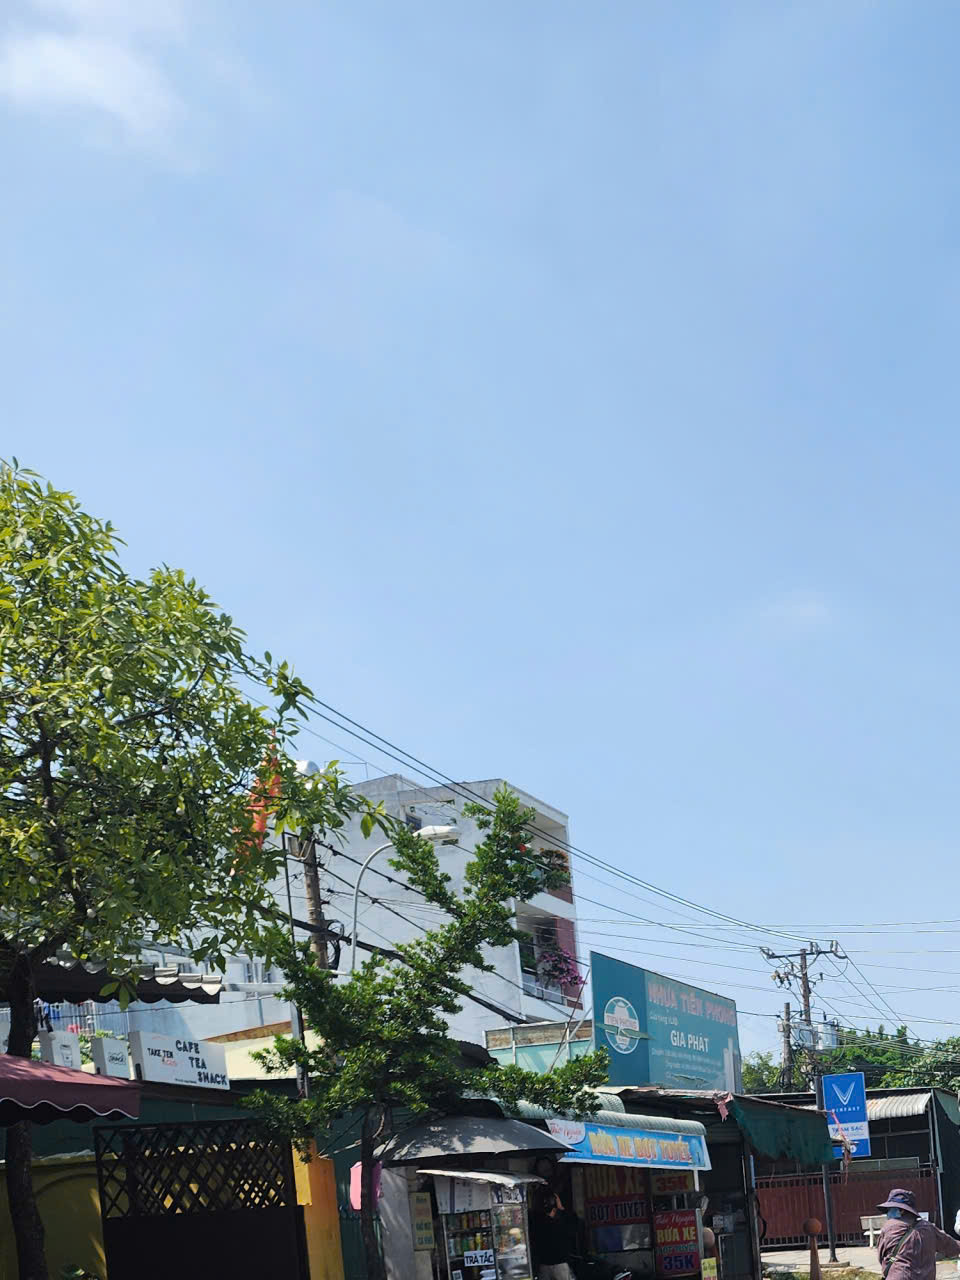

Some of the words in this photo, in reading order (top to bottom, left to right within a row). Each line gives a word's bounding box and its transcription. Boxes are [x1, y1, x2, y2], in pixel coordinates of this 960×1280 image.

[670, 1030, 686, 1048] GIA
[147, 1047, 161, 1057] TAKE
[188, 1056, 207, 1069] TEA
[197, 1071, 228, 1085] SNACK
[664, 1255, 694, 1270] 35K
